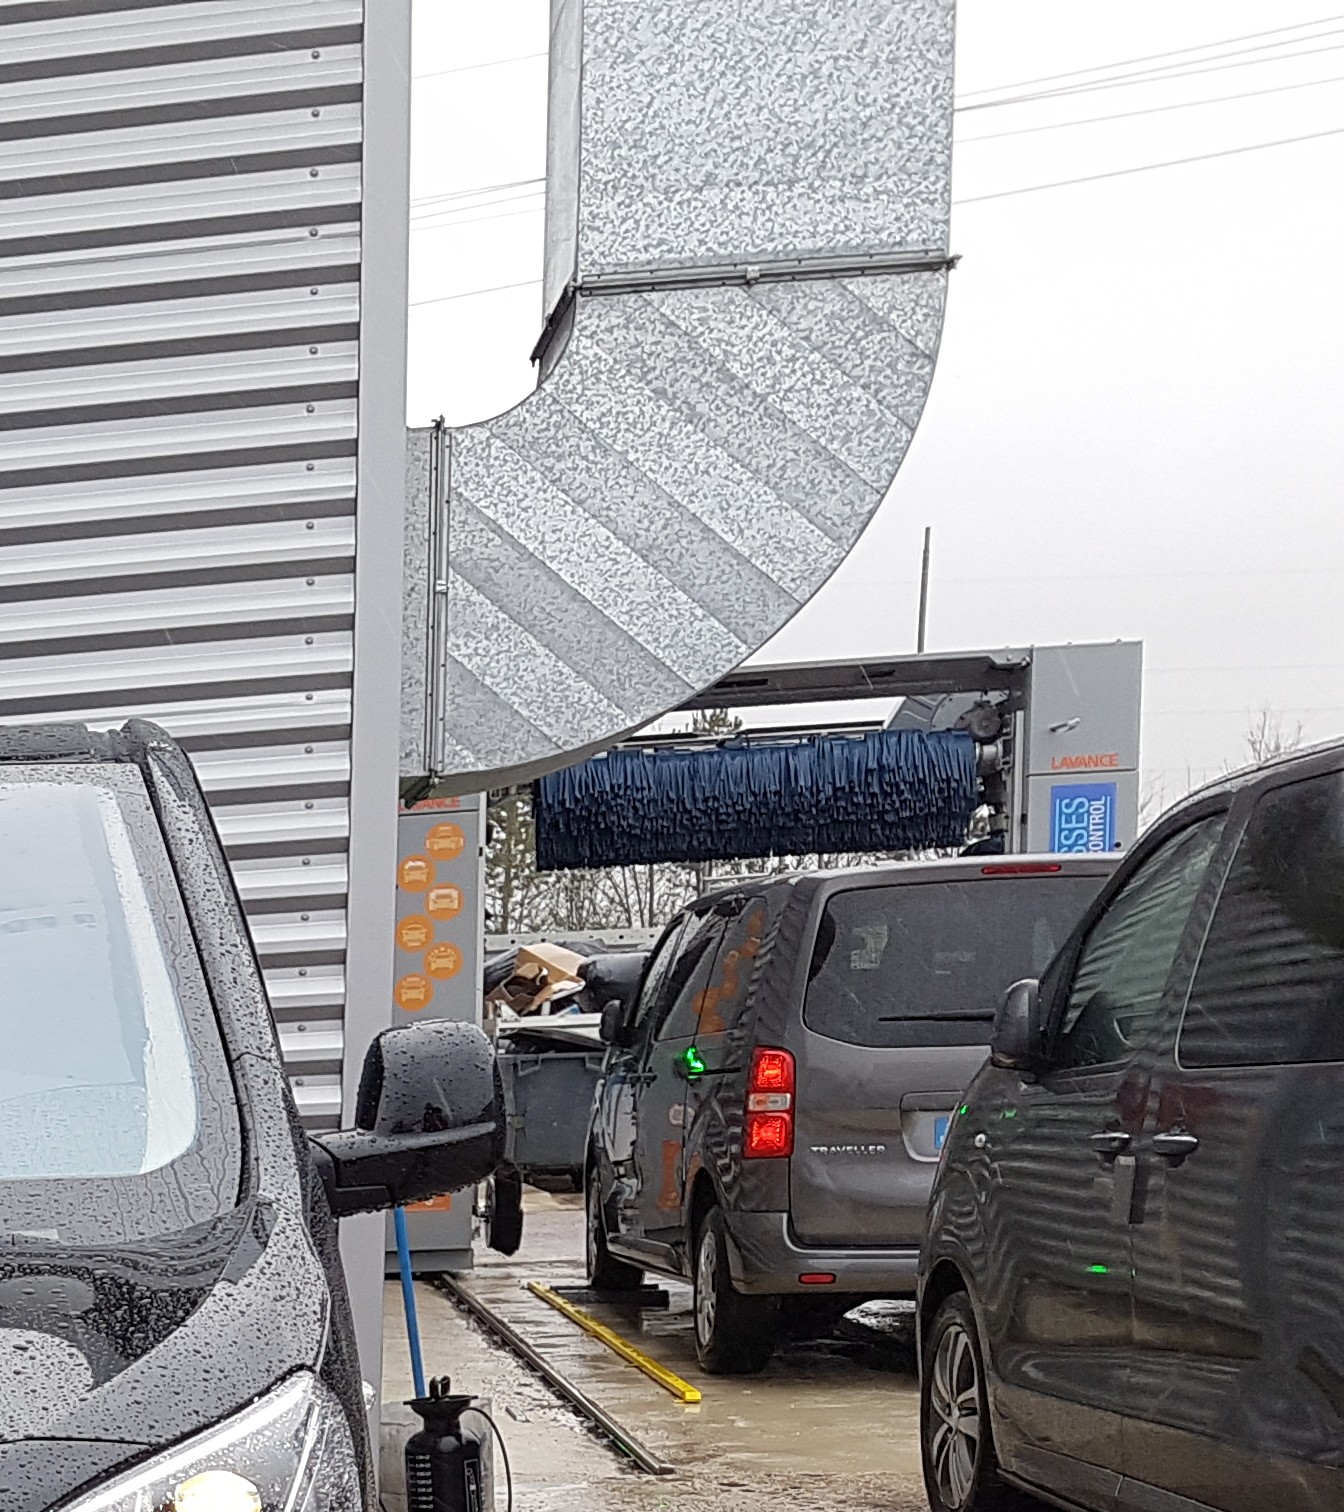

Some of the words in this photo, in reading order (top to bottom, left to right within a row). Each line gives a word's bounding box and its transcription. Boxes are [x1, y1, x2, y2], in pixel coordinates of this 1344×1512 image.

[1050, 752, 1119, 770] LAVANCE
[1088, 795, 1106, 853] ONTROL
[810, 1145, 886, 1155] TRAVELLER
